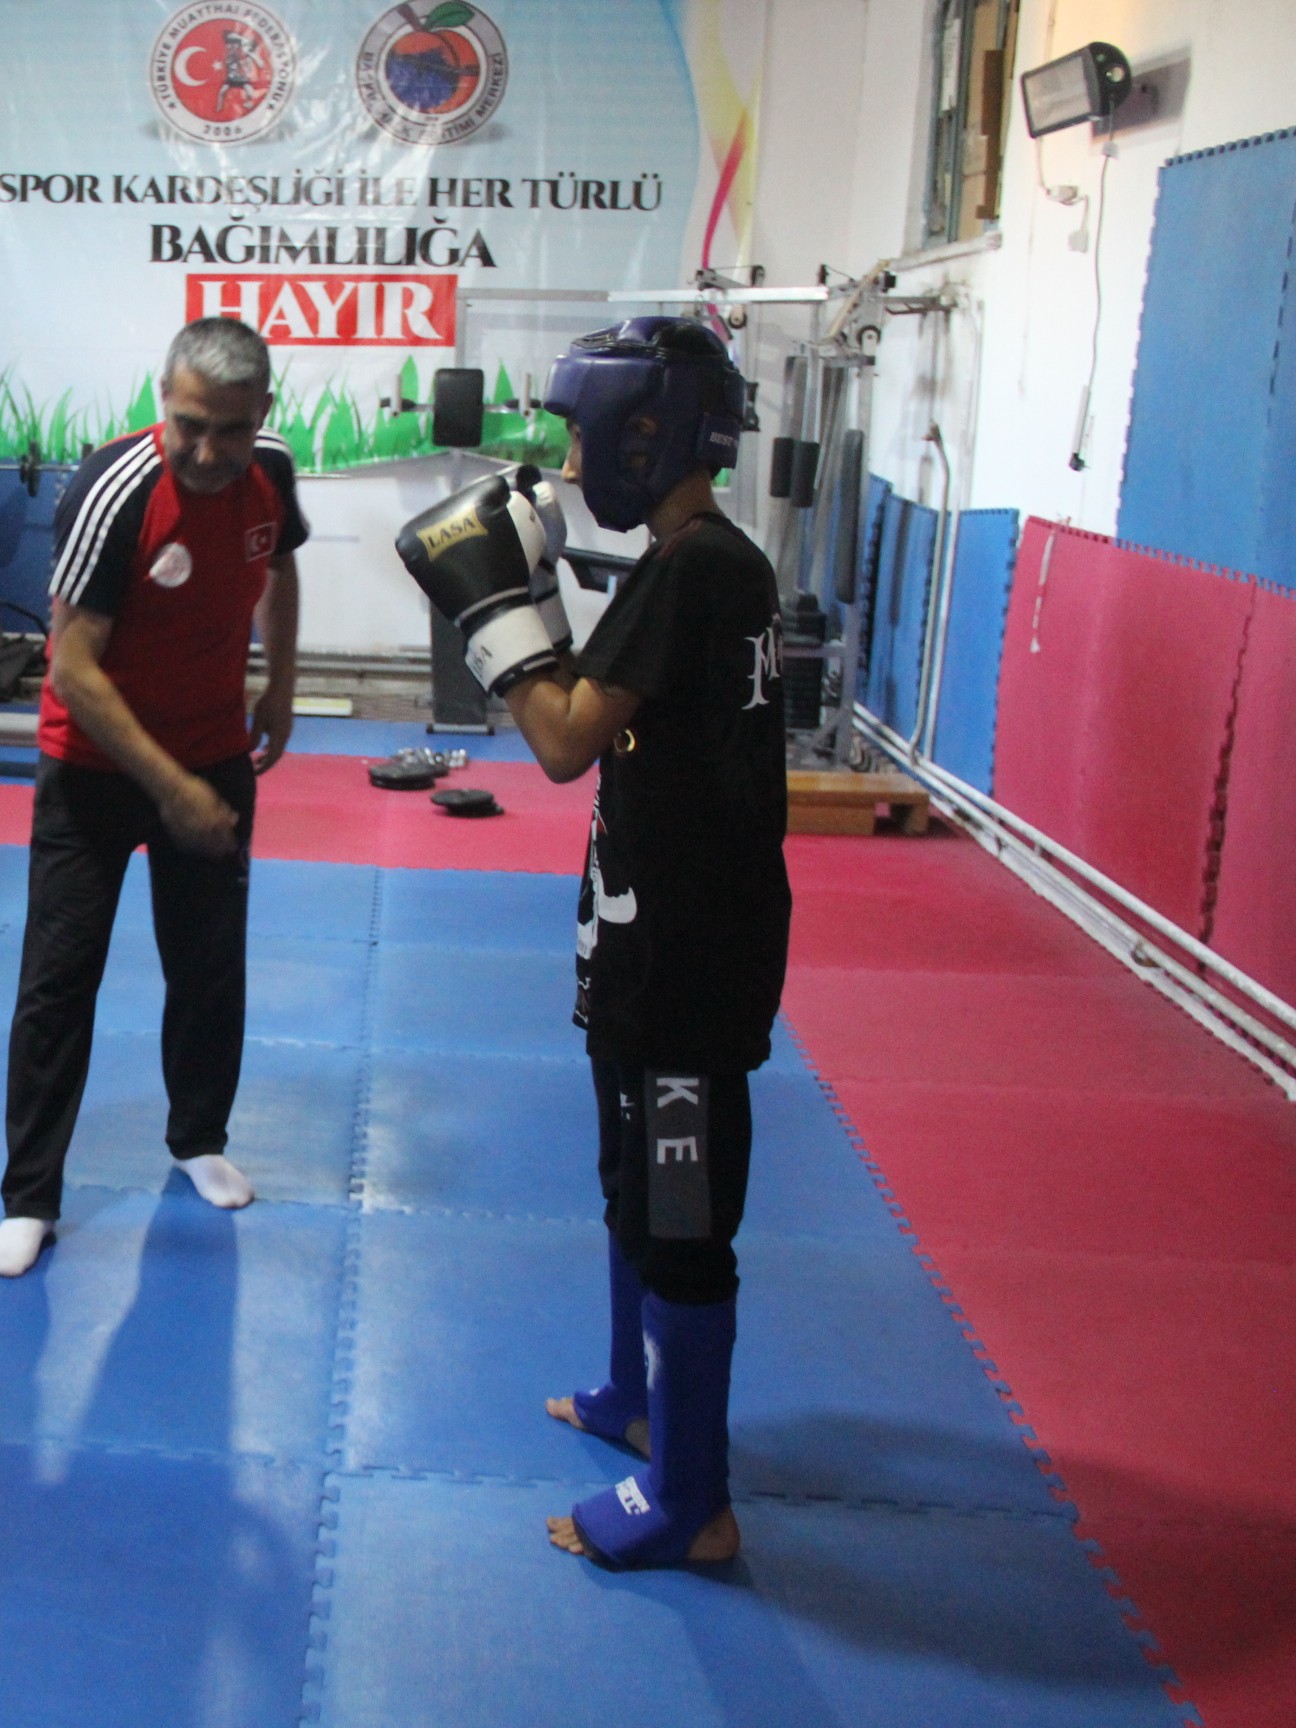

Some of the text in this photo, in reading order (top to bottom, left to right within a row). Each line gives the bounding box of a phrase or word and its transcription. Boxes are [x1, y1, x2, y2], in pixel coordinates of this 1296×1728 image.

[156, 43, 171, 100] TÜRKİYE
[112, 168, 346, 213] KARDEŞLİĞİ
[357, 168, 417, 207] İLE
[428, 177, 514, 209] HER
[522, 170, 663, 211] TÜRLÜ
[150, 214, 498, 268] BAĞIMLILIĞA
[197, 280, 444, 340] HAYIR
[427, 516, 476, 549] LASA
